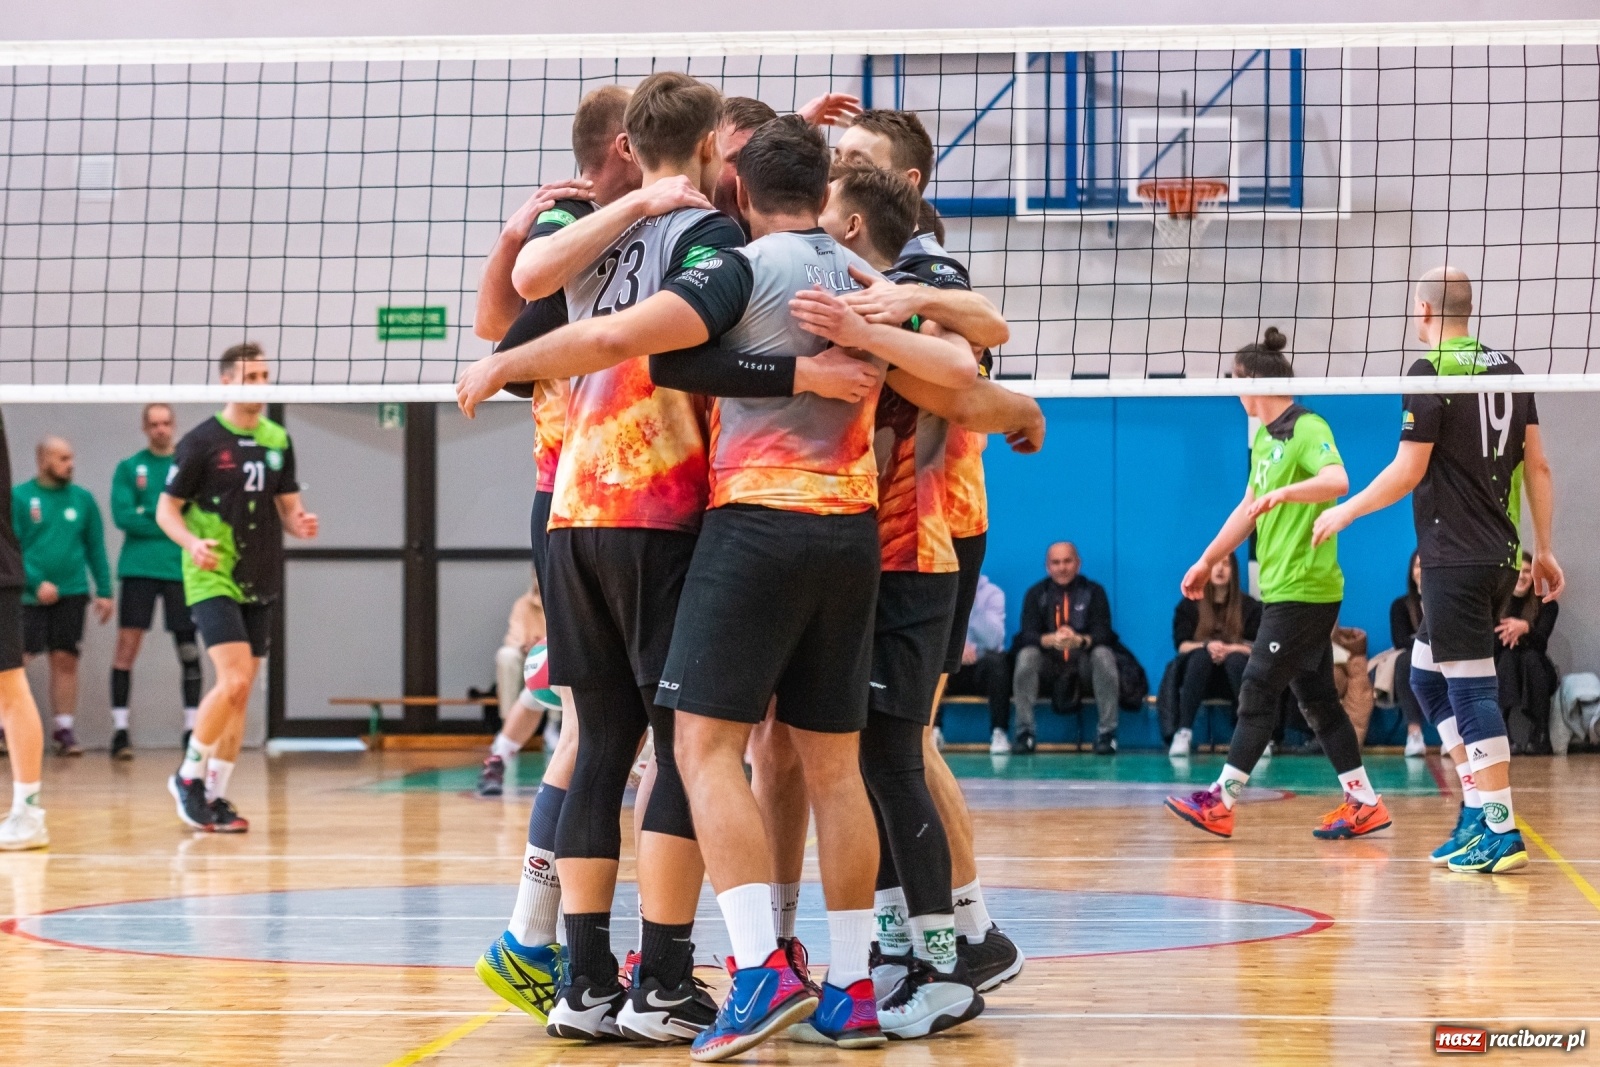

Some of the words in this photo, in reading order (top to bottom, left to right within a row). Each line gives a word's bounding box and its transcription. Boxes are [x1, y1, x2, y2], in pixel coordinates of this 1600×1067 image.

[592, 239, 646, 317] 23
[804, 264, 822, 285] KS
[738, 360, 775, 371] KIPSTA
[1478, 392, 1513, 457] 19
[243, 461, 265, 491] 21
